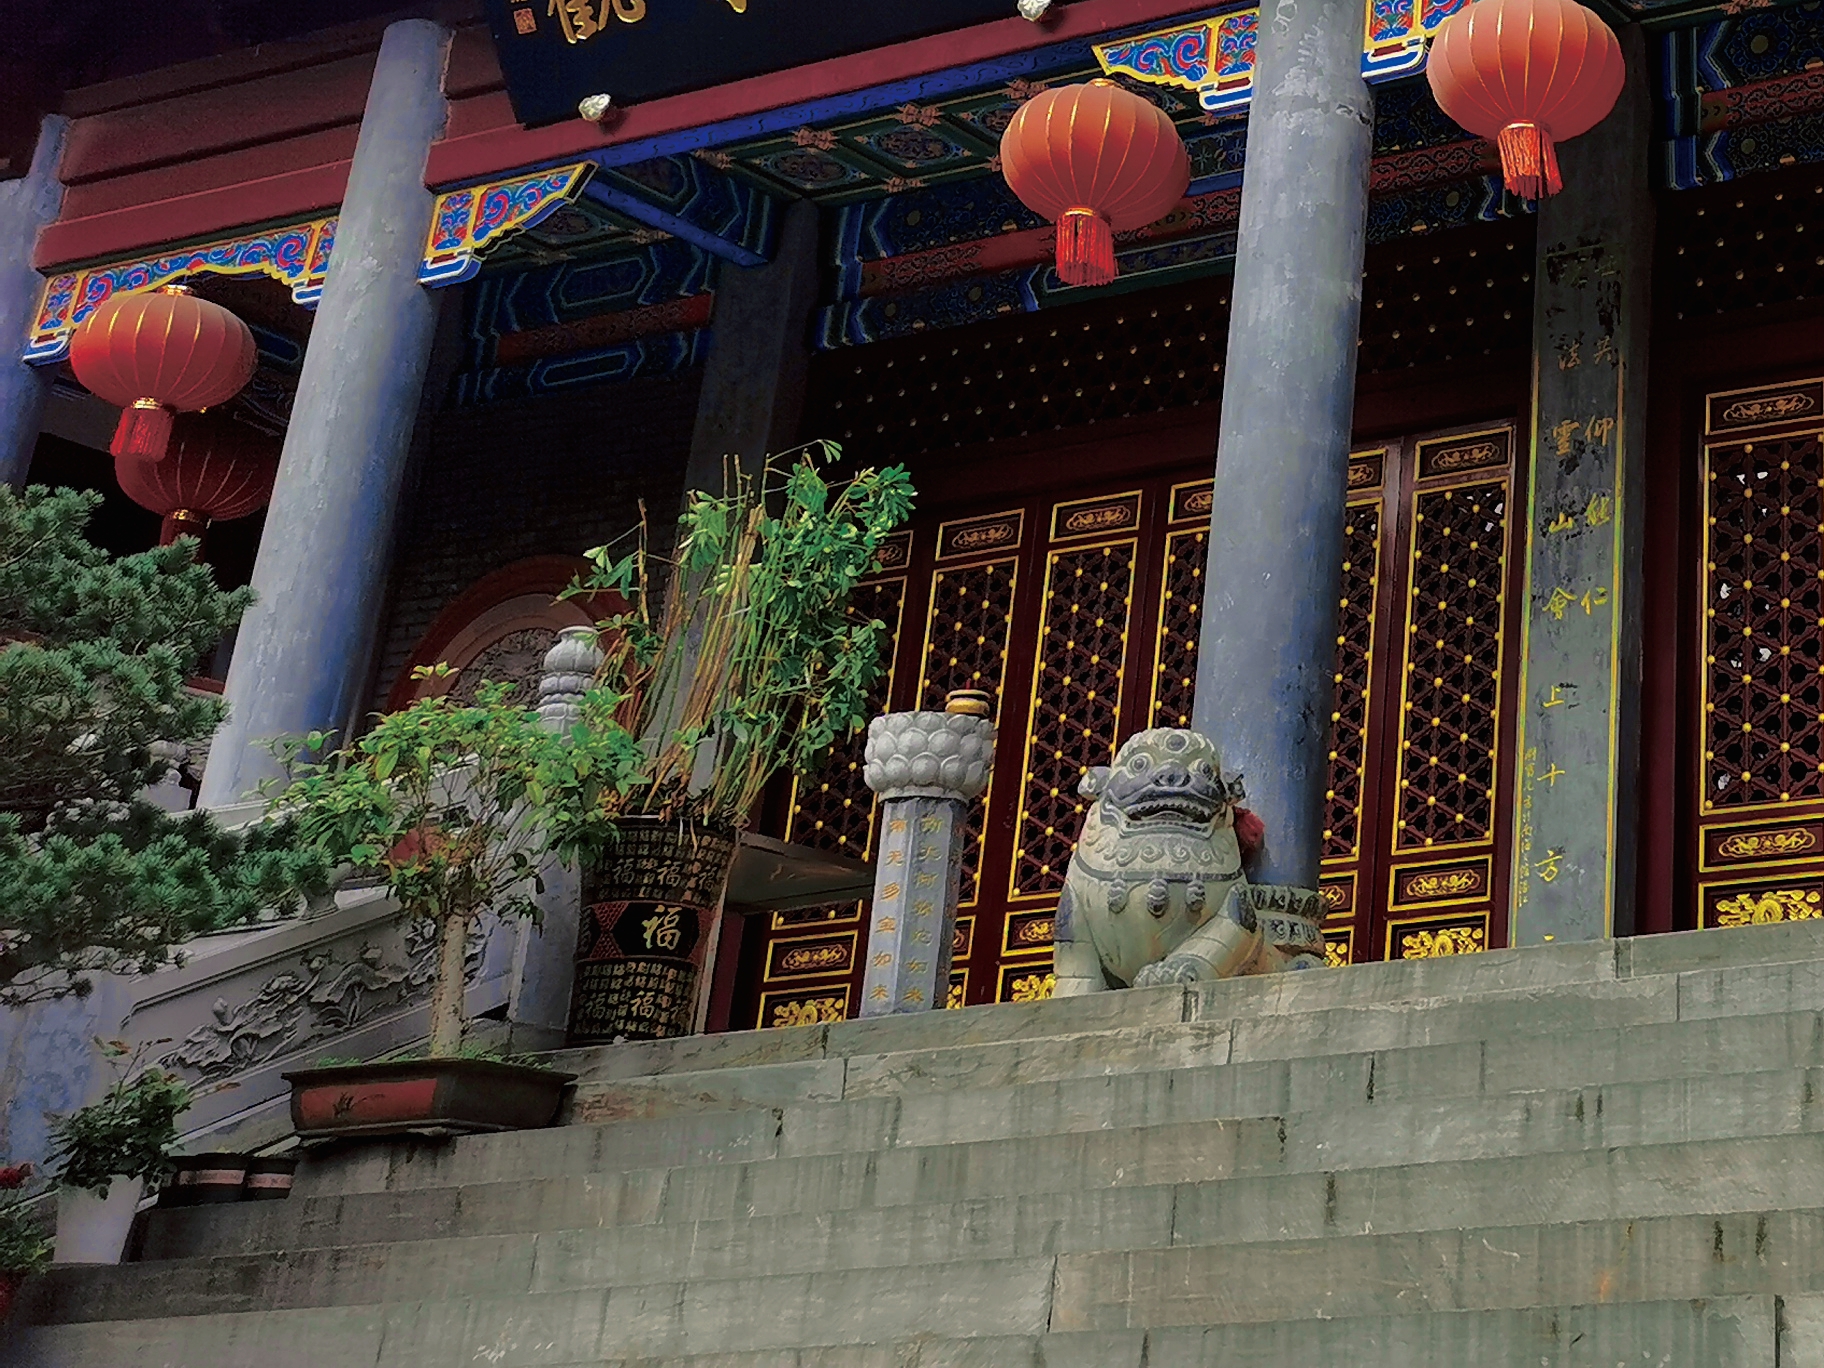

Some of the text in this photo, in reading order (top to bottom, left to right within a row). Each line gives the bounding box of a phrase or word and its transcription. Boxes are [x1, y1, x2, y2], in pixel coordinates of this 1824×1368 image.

[657, 859, 683, 888] 福
[641, 904, 682, 951] 福
[630, 990, 655, 1019] 福
